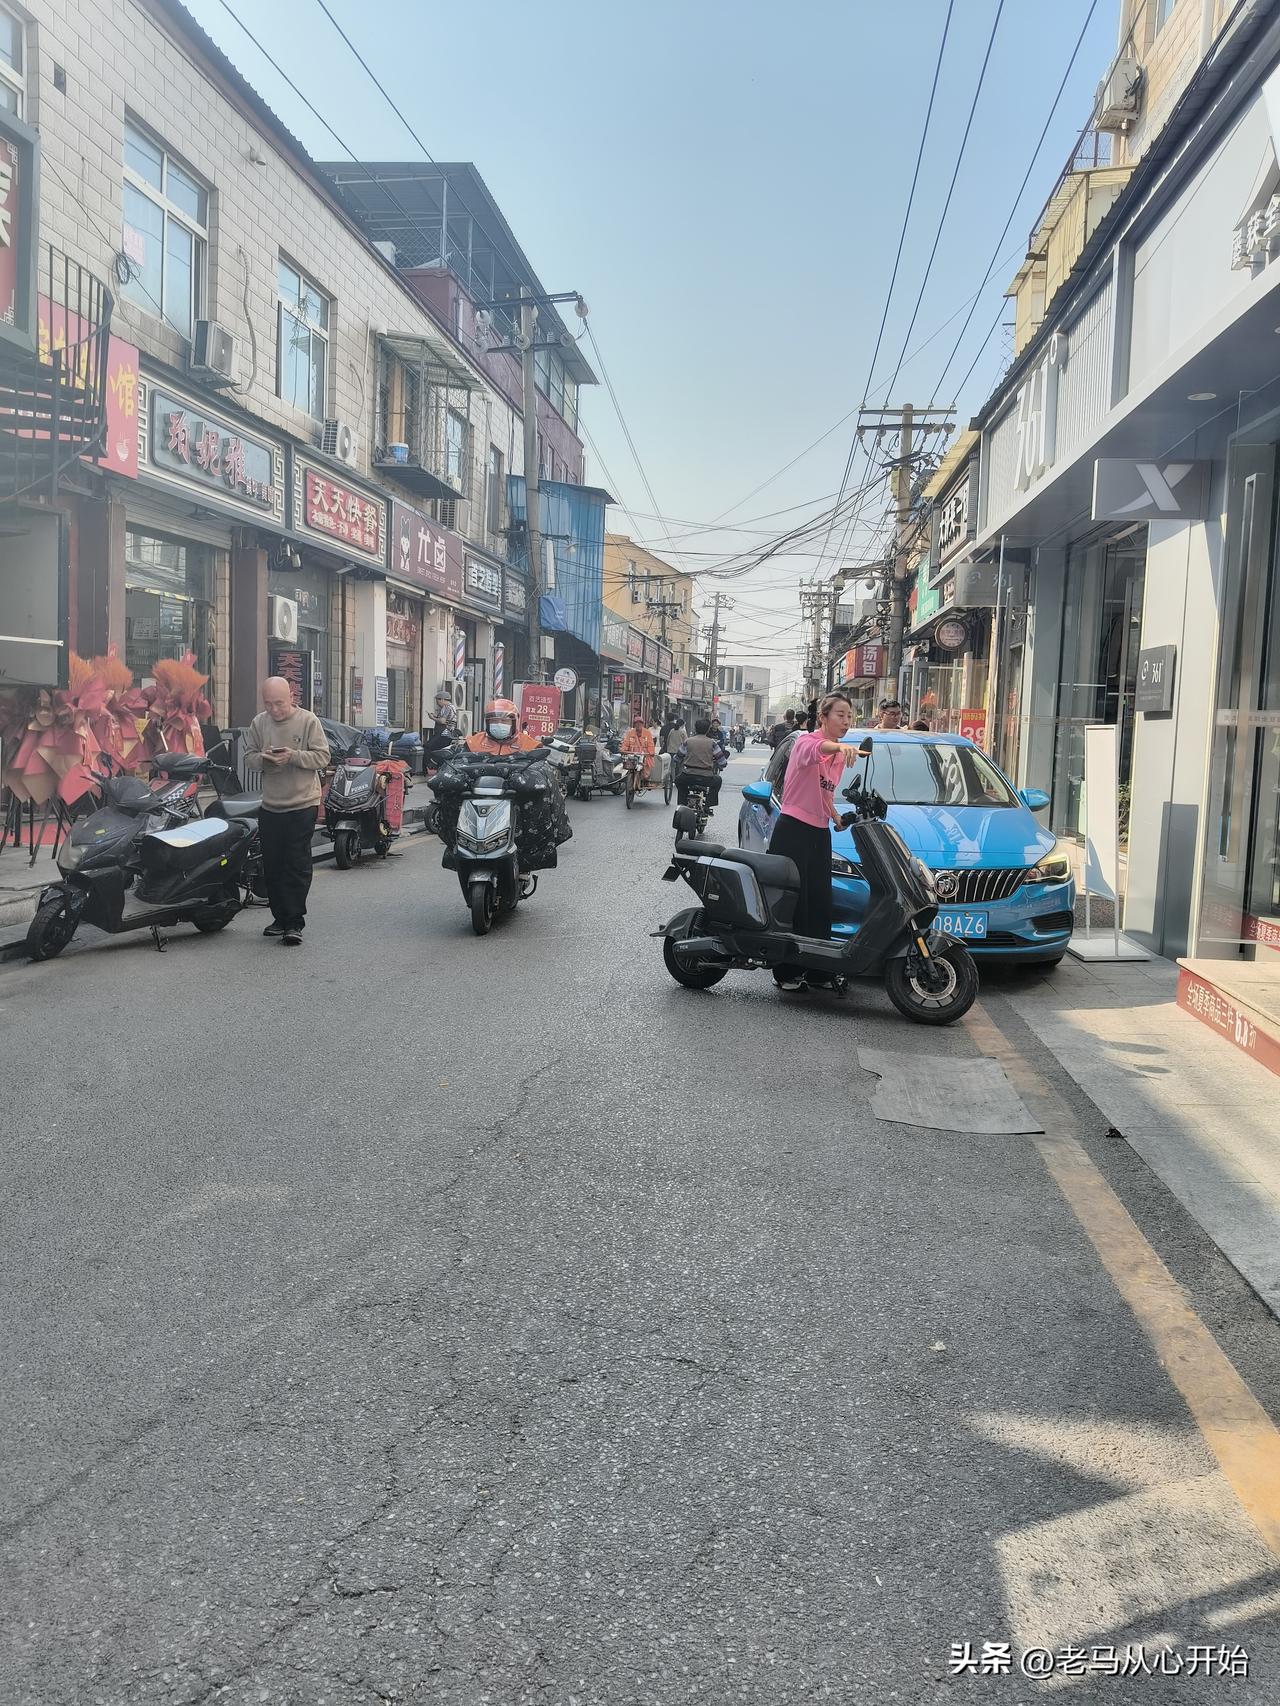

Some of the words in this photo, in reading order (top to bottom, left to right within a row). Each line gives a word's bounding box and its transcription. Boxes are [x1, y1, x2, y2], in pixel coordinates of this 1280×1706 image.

[312, 477, 378, 535] 天天快餐
[862, 646, 879, 675] 汤包
[541, 721, 554, 733] 88
